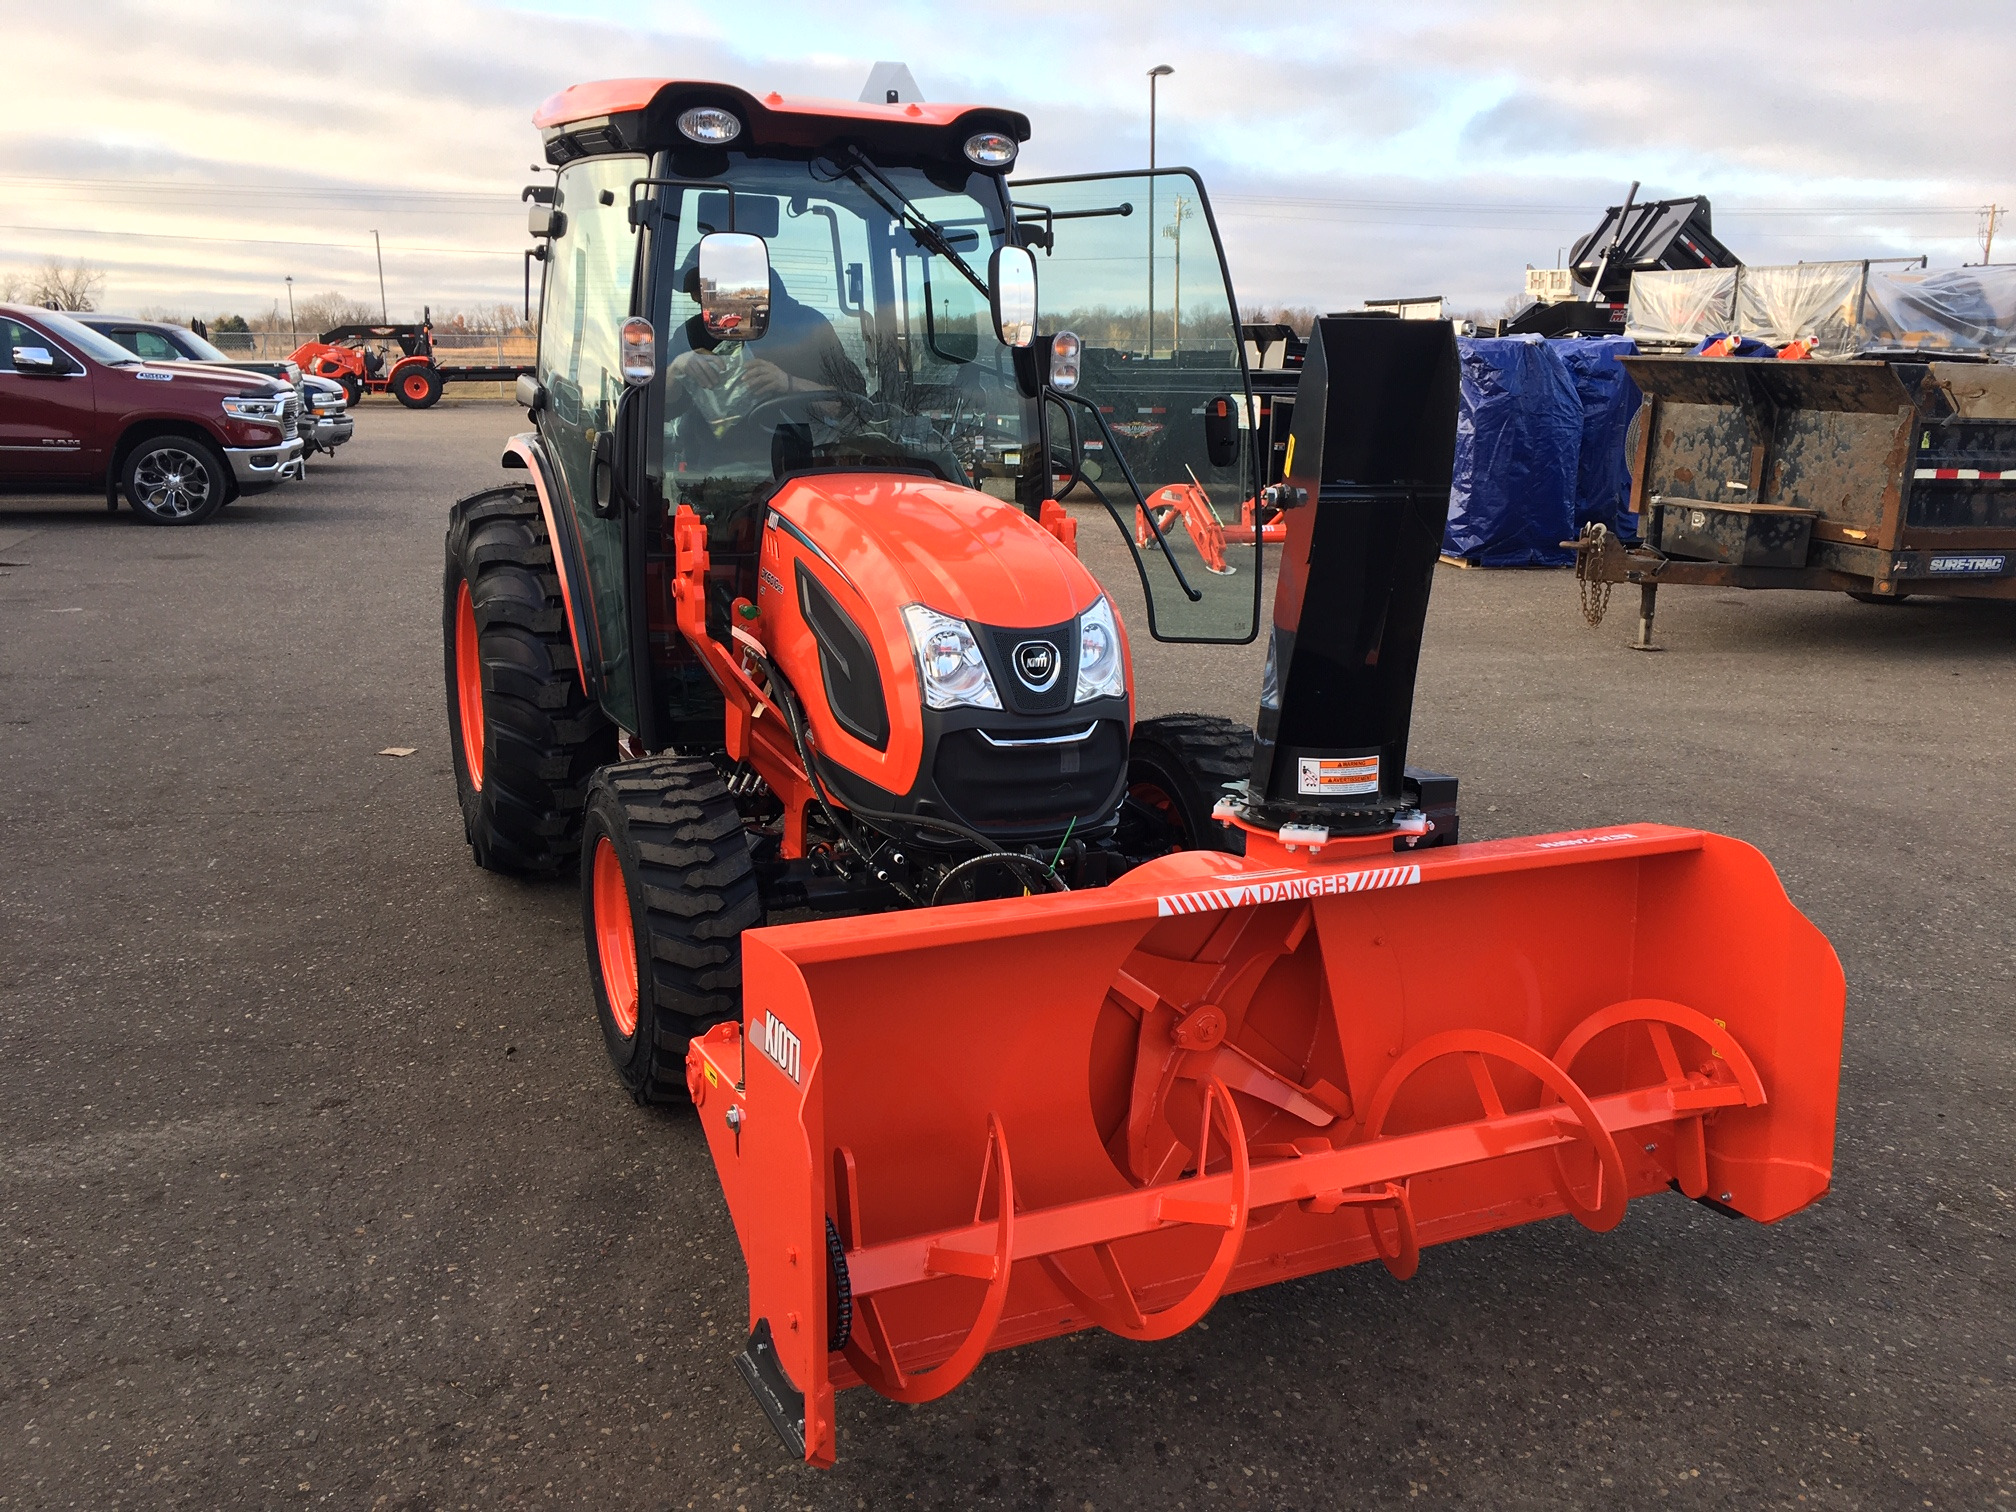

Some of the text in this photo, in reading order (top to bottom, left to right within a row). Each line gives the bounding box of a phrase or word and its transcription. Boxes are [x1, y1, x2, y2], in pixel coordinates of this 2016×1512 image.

[1930, 558, 2002, 571] SURE-TRAC
[1259, 874, 1351, 904] DANGER
[765, 1008, 801, 1085] KIOTI
